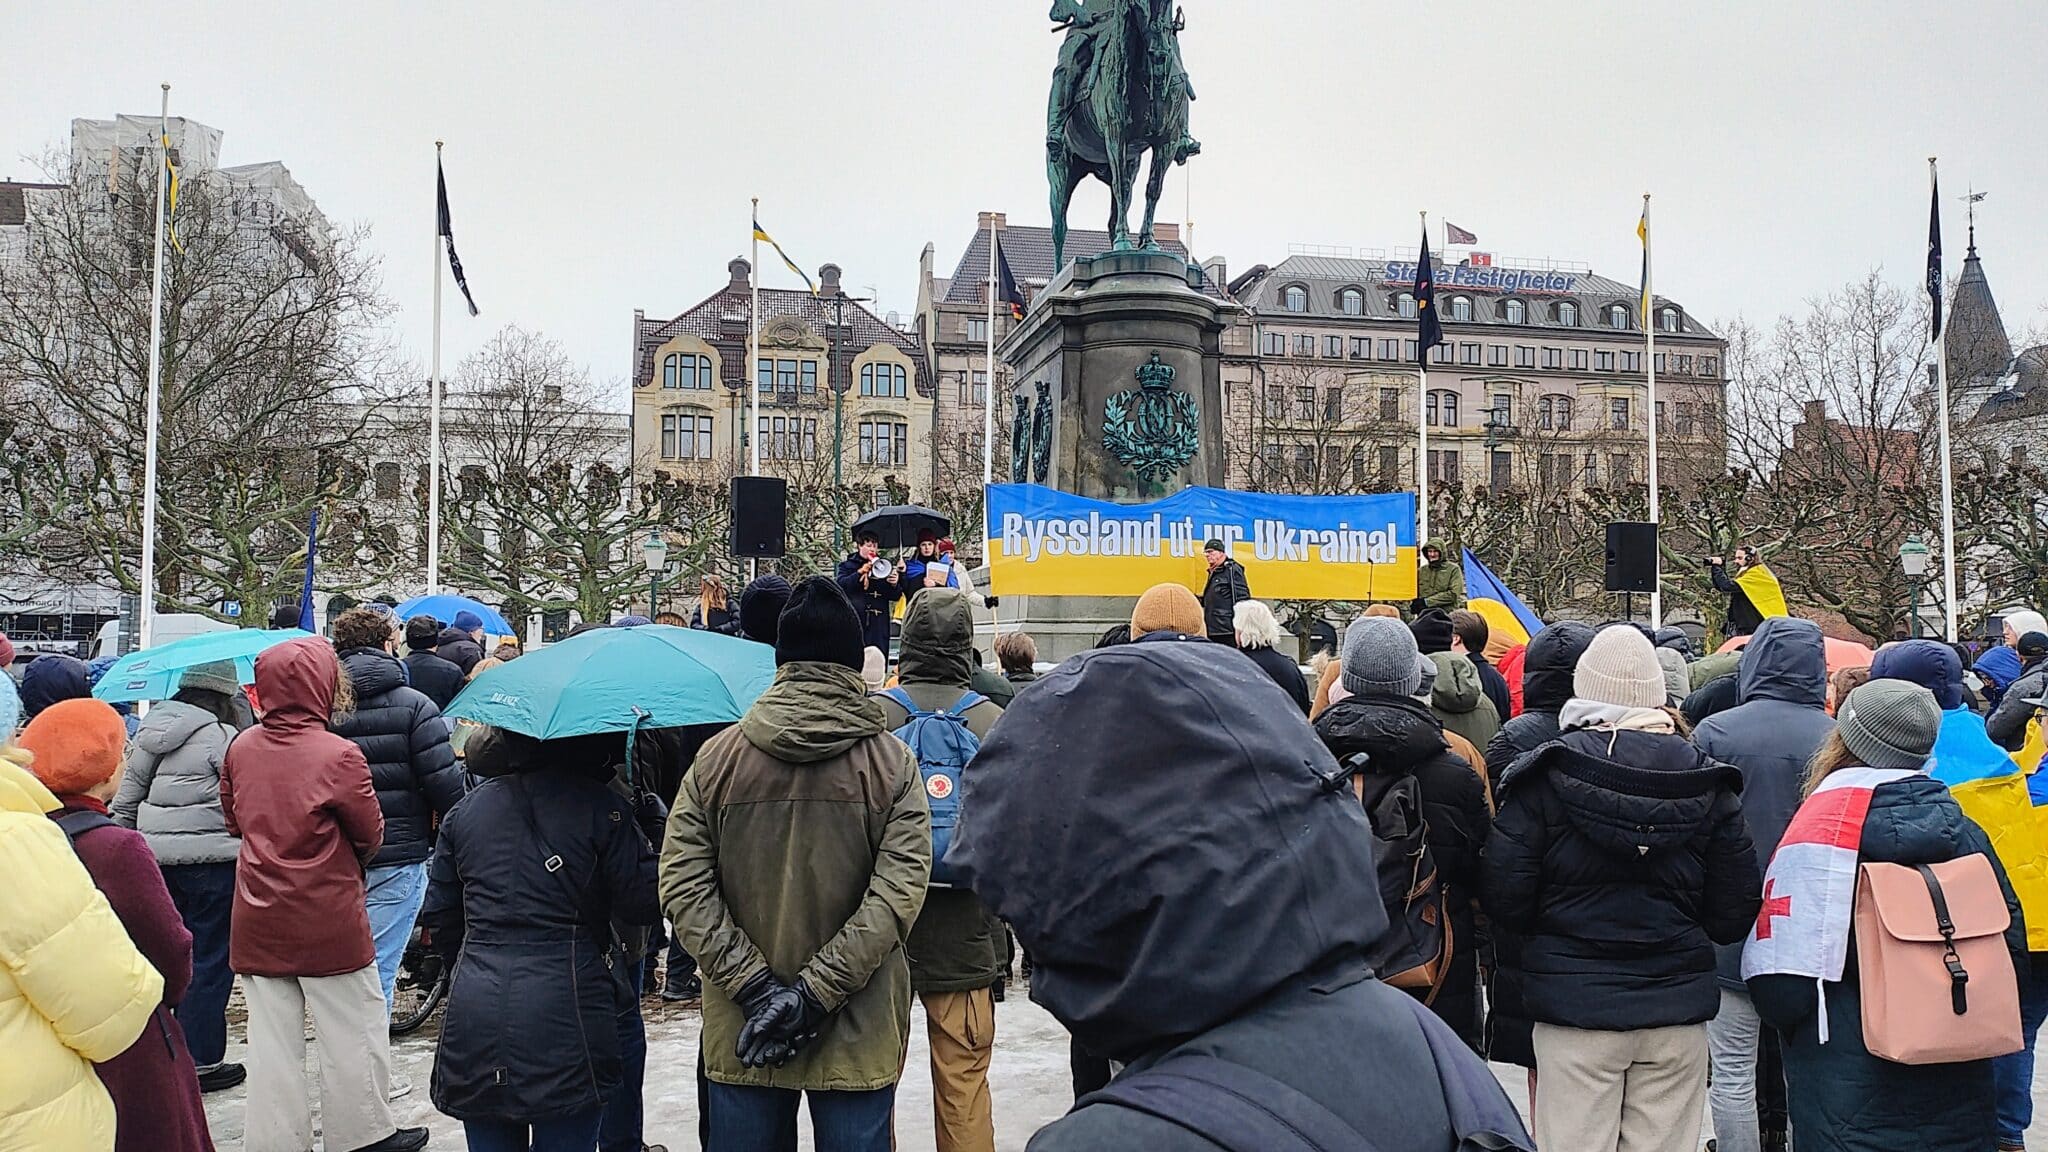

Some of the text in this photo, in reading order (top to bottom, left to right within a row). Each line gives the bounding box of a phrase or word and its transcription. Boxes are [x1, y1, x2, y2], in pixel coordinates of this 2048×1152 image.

[1384, 262, 1577, 294] Stea Fastigheter
[1002, 510, 1161, 563] Ryssland
[1169, 515, 1195, 558] ut
[1252, 518, 1398, 564] Ukraina!
[228, 602, 238, 615] P
